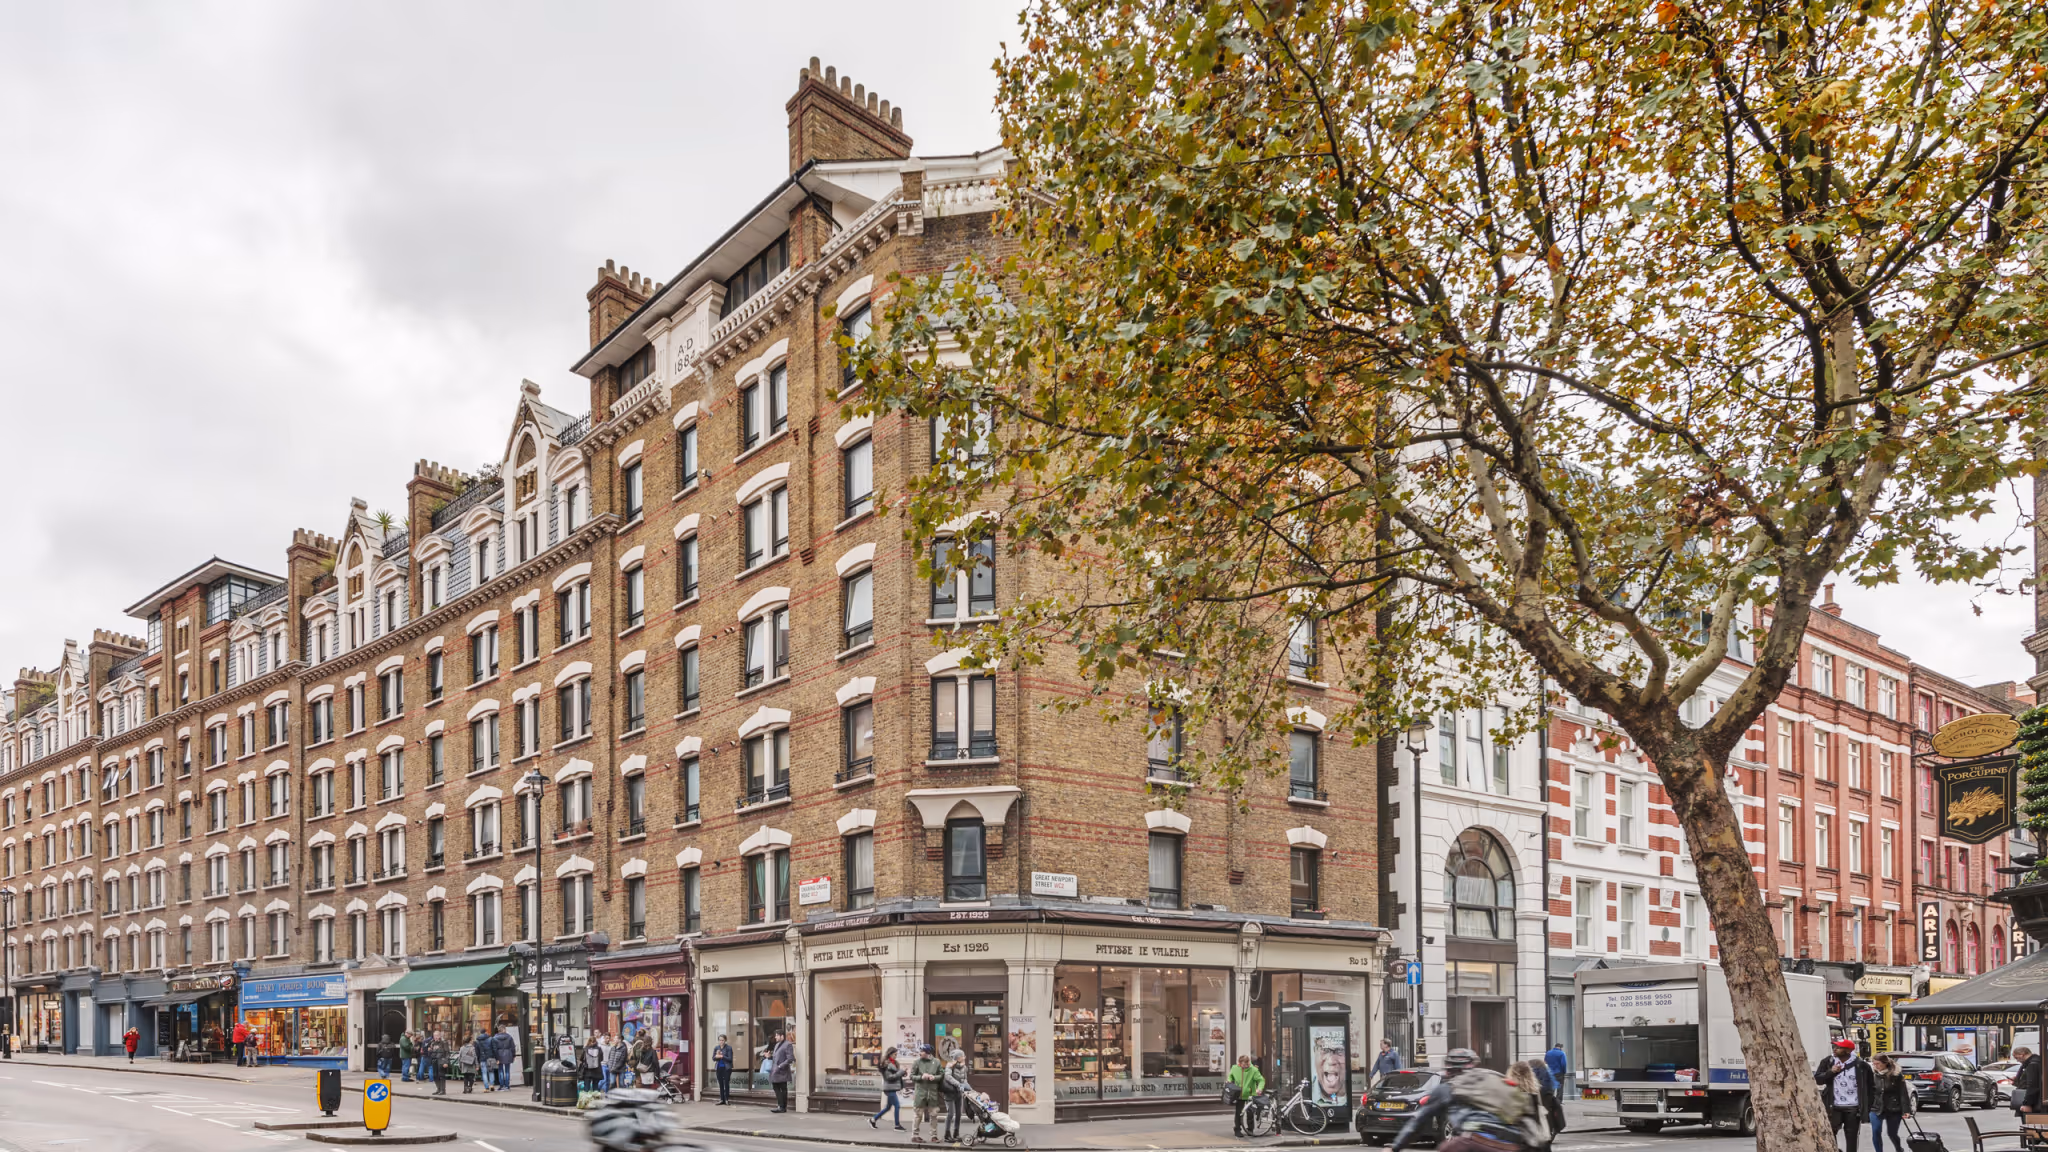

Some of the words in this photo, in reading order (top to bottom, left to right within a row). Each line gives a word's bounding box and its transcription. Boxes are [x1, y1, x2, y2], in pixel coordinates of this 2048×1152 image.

[1943, 728, 2008, 745] NICHOLSON'S
[1947, 766, 2008, 780] PORCUPINE
[1051, 876, 1074, 884] NEWPORT
[814, 920, 845, 931] PATISSERIE
[846, 917, 870, 926] VALERIE
[1922, 904, 1939, 958] ARTS
[856, 945, 889, 957] VALERIE
[943, 943, 960, 953] Est
[964, 942, 989, 952] 1926
[1152, 947, 1190, 958] VALERIE
[256, 984, 275, 992] HENRY
[1910, 1013, 1940, 1025] GREAT
[1941, 1014, 1980, 1024] BRITISH
[1982, 1013, 2004, 1024] PUB
[2006, 1012, 2038, 1024] FOOD
[1430, 1022, 1442, 1035] 12
[1532, 1022, 1542, 1034] 12
[1131, 1084, 1156, 1093] LUNCH
